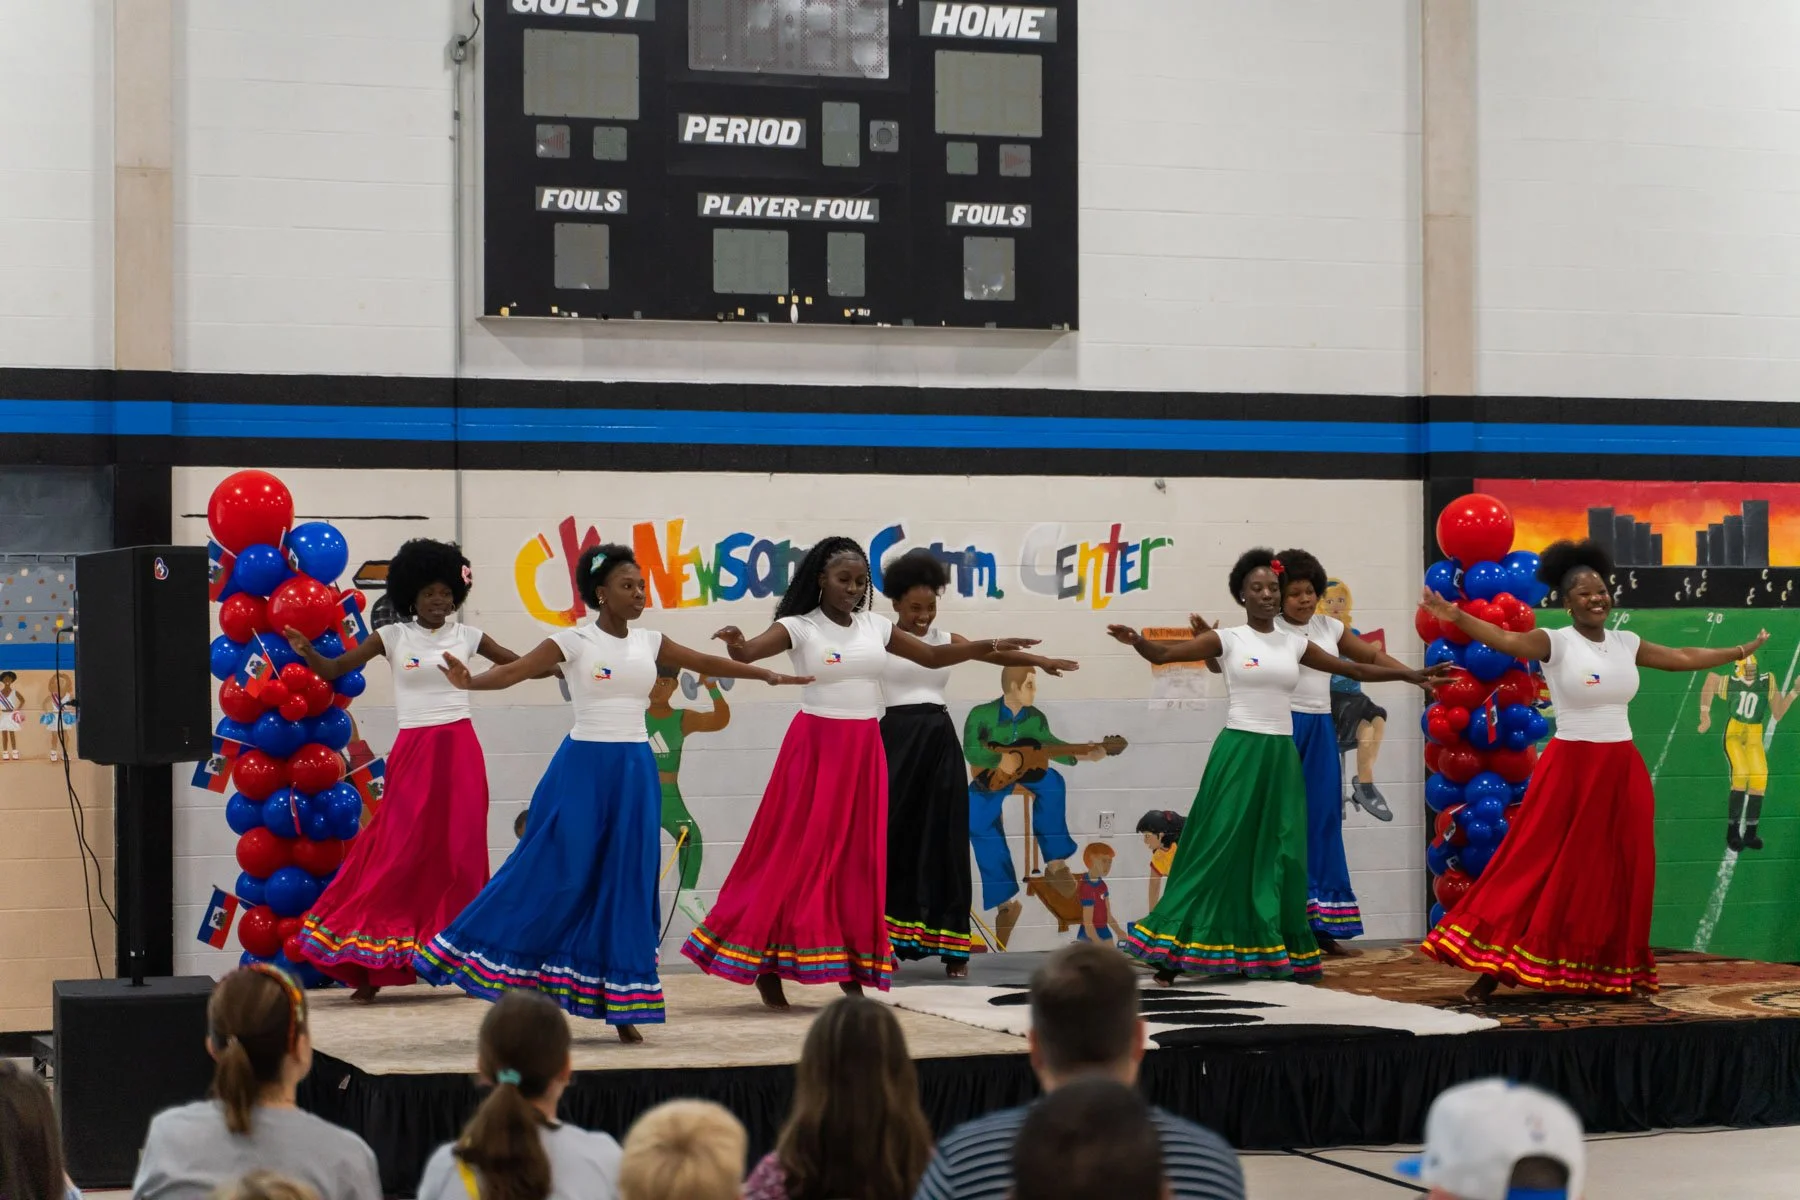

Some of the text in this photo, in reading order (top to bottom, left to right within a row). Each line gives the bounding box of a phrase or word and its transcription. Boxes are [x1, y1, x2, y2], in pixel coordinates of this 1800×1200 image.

[931, 3, 1046, 40] HOME
[684, 115, 801, 146] PERIOD
[541, 189, 622, 212] FOULS
[703, 195, 874, 220] PLAYER-FOUL
[951, 204, 1027, 226] FOULS
[1706, 611, 1723, 624] 20
[1736, 690, 1759, 719] 10
